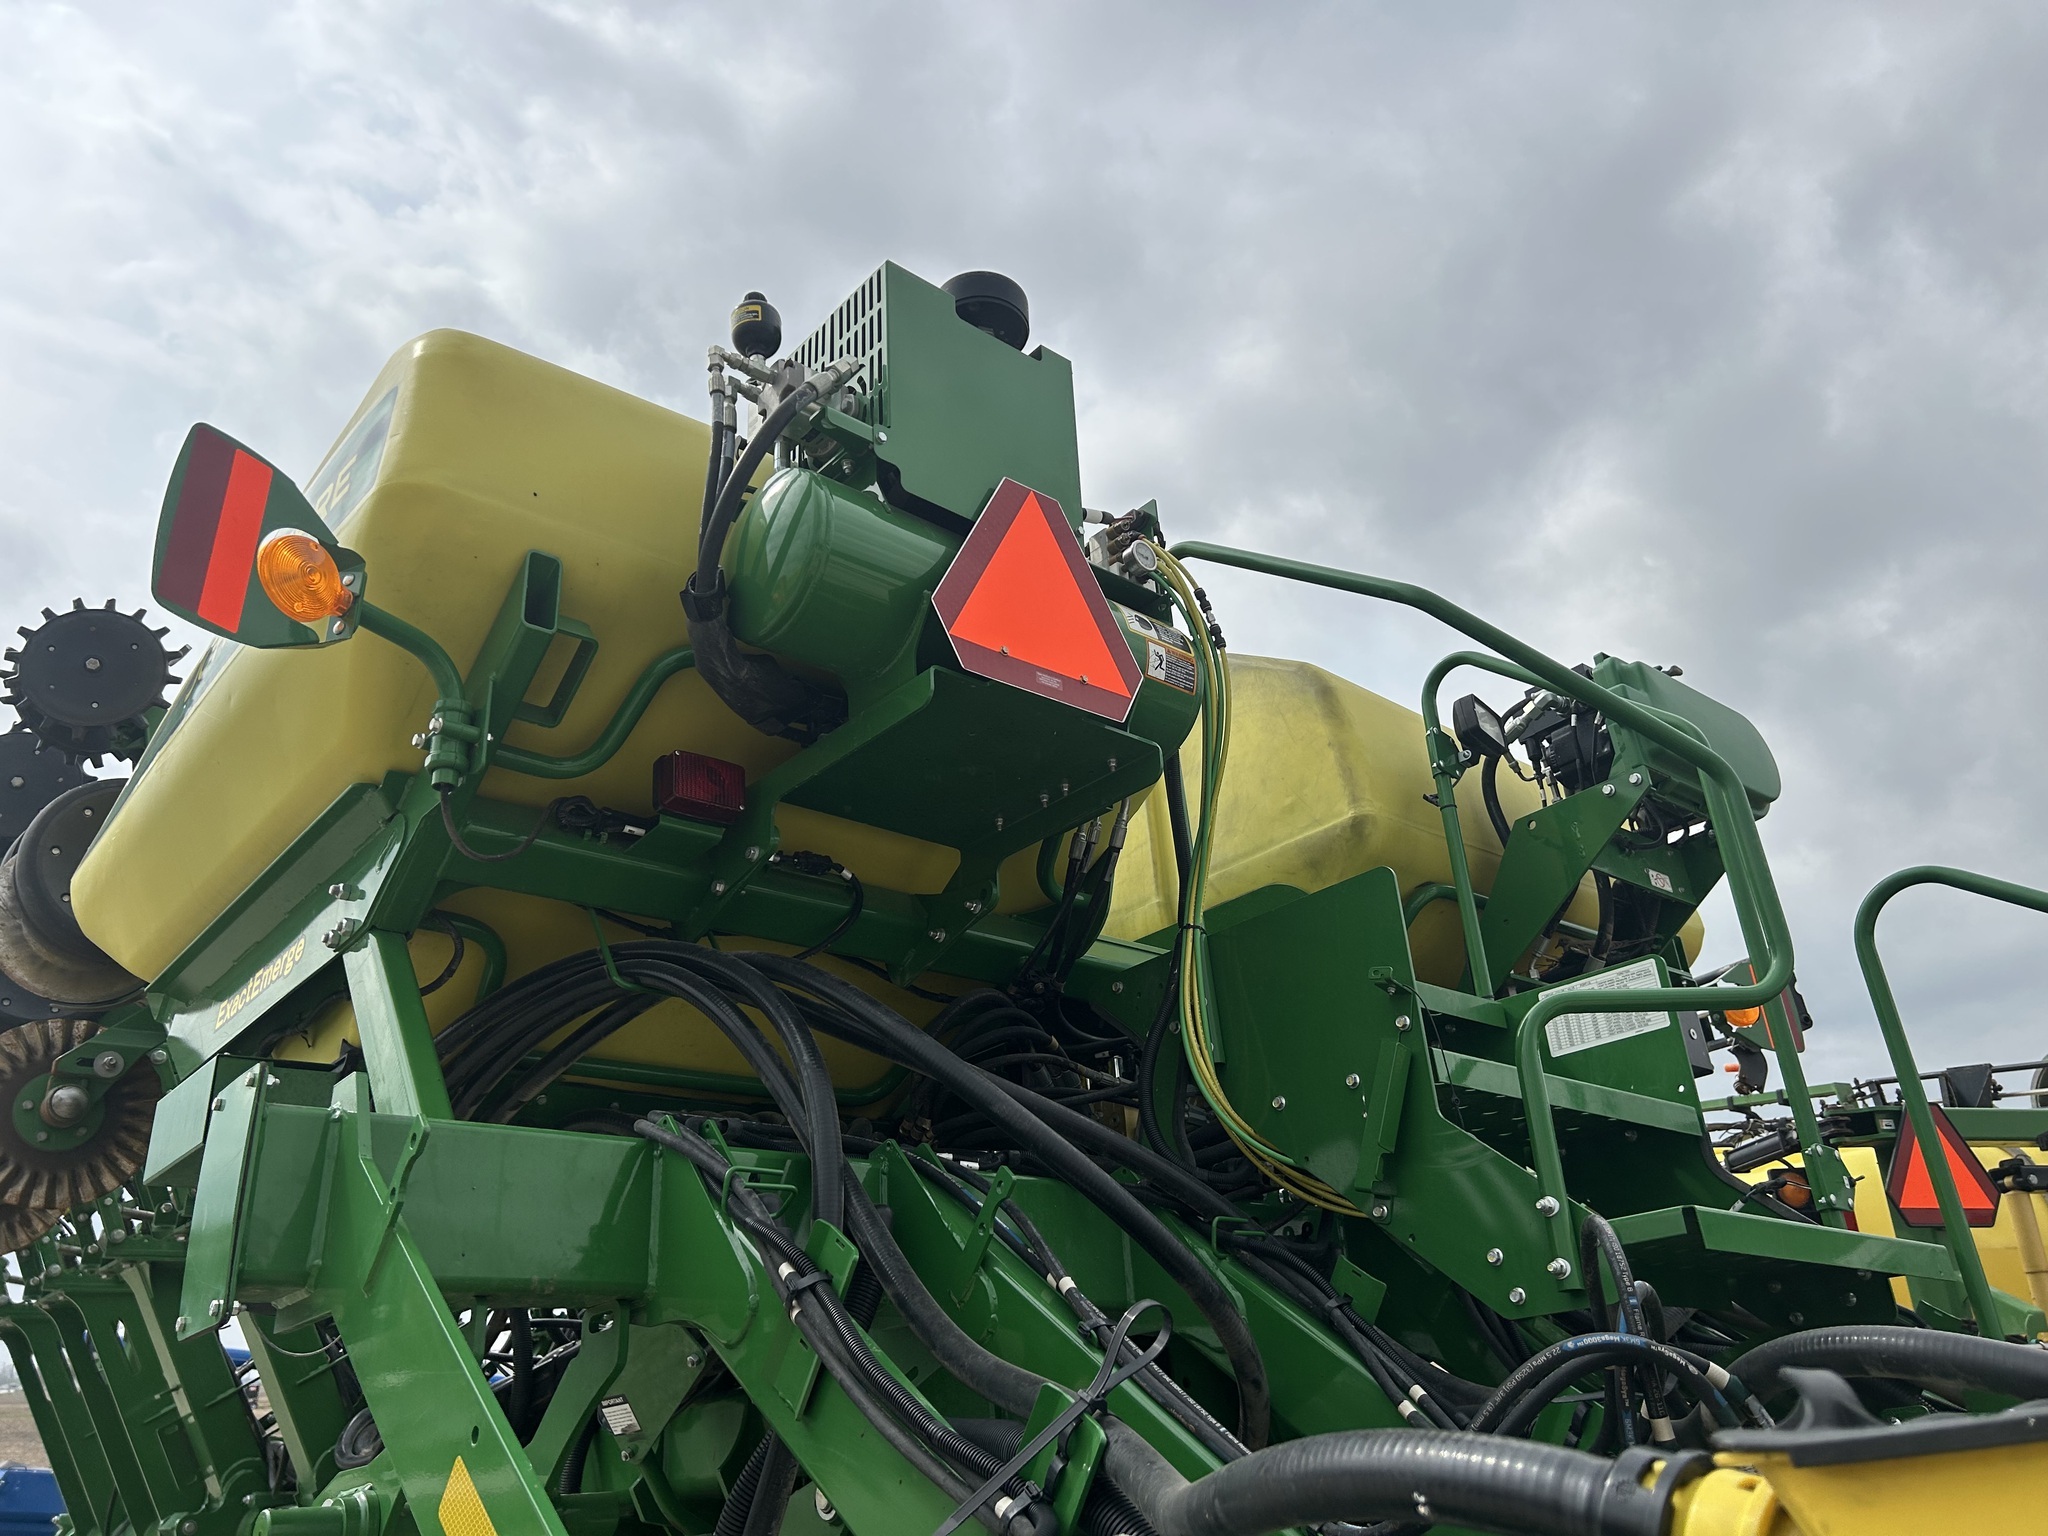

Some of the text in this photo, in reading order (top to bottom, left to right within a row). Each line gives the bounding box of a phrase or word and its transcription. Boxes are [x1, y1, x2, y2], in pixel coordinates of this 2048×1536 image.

[214, 936, 306, 1031] ExactEmerge
[1614, 1250, 1627, 1271] 18752
[1621, 1270, 1632, 1287] Type
[1626, 1285, 1634, 1293] B
[1631, 1307, 1644, 1331] Flame
[1532, 1355, 1547, 1367] MPa
[1546, 1346, 1562, 1359] 22.5
